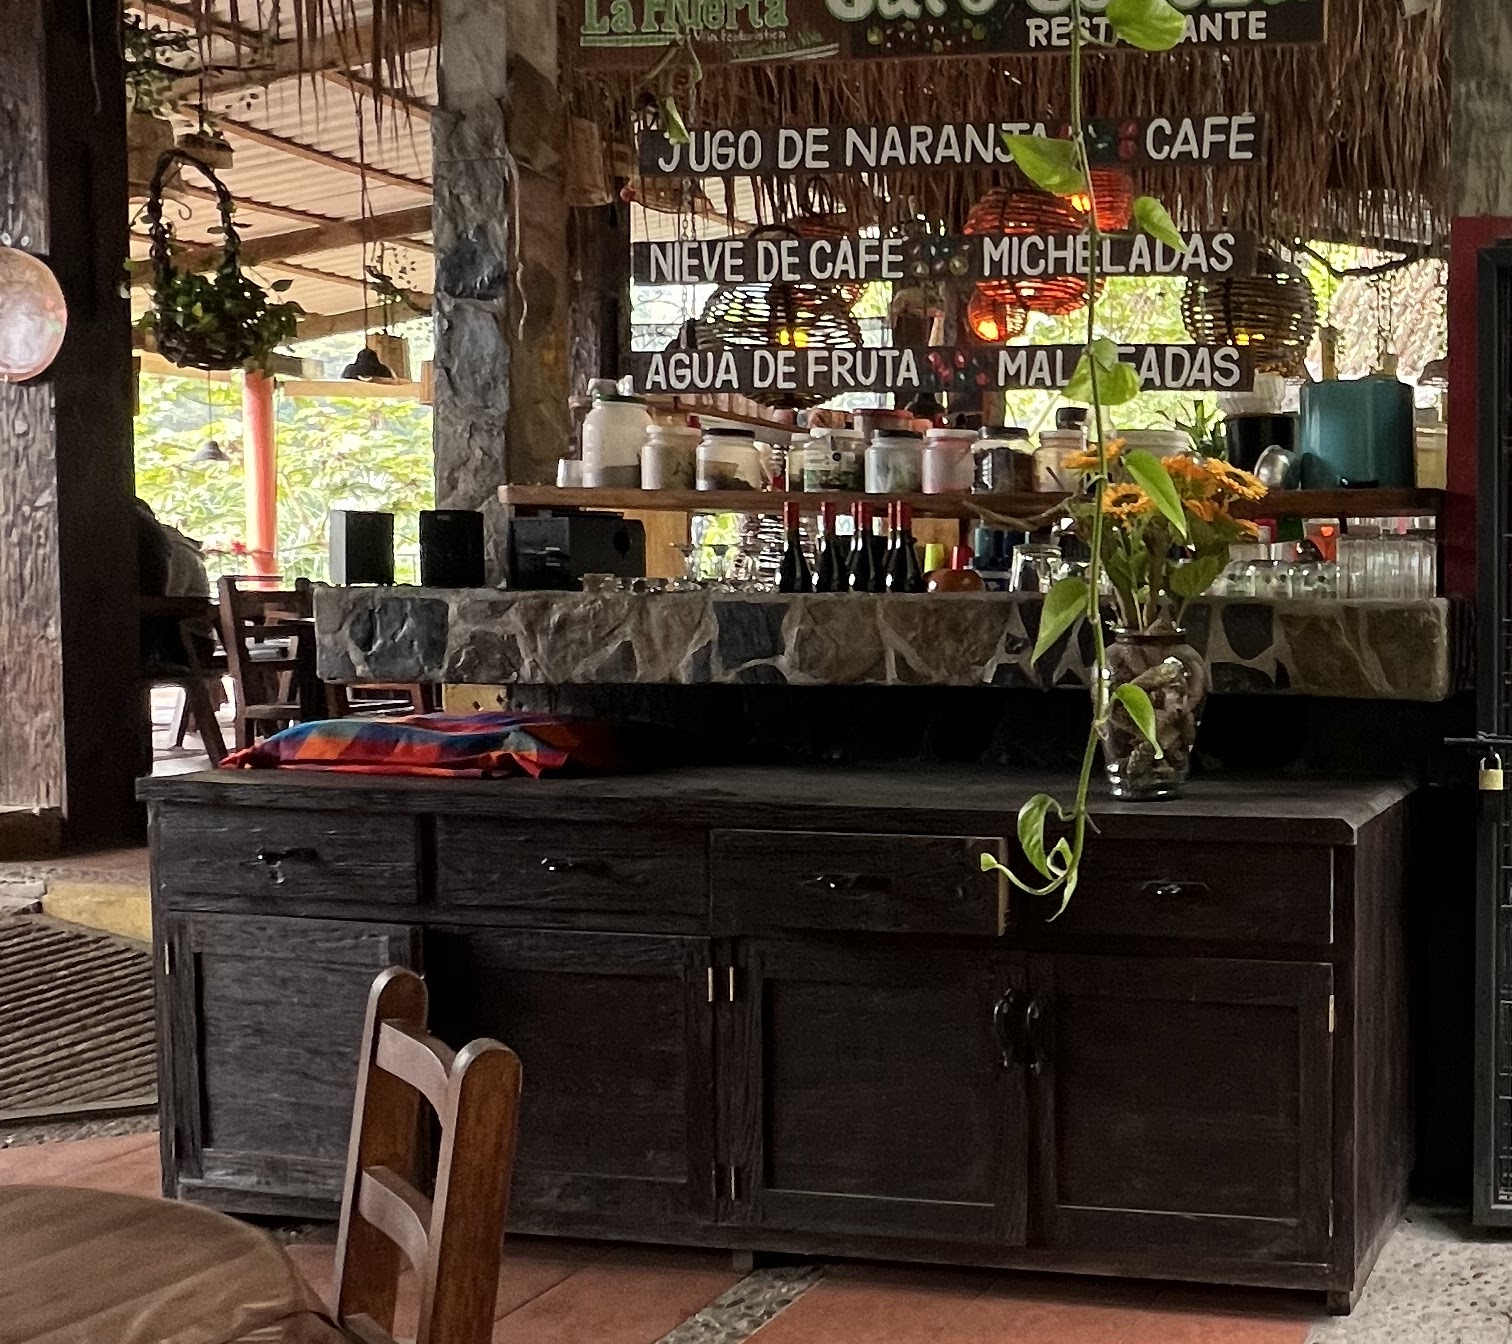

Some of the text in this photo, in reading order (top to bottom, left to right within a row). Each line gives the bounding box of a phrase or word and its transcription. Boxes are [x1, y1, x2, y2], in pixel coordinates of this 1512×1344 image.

[1026, 10, 1267, 48] RESTANTE
[658, 129, 762, 172] JUGO
[777, 127, 830, 169] DE
[1146, 115, 1256, 160] CAFE
[650, 237, 904, 283] NIEVE DE CAFE
[983, 232, 1236, 277] MICHELADAS
[645, 348, 920, 390] AGUA DE FRUTA
[997, 346, 1241, 387] MALADAS
